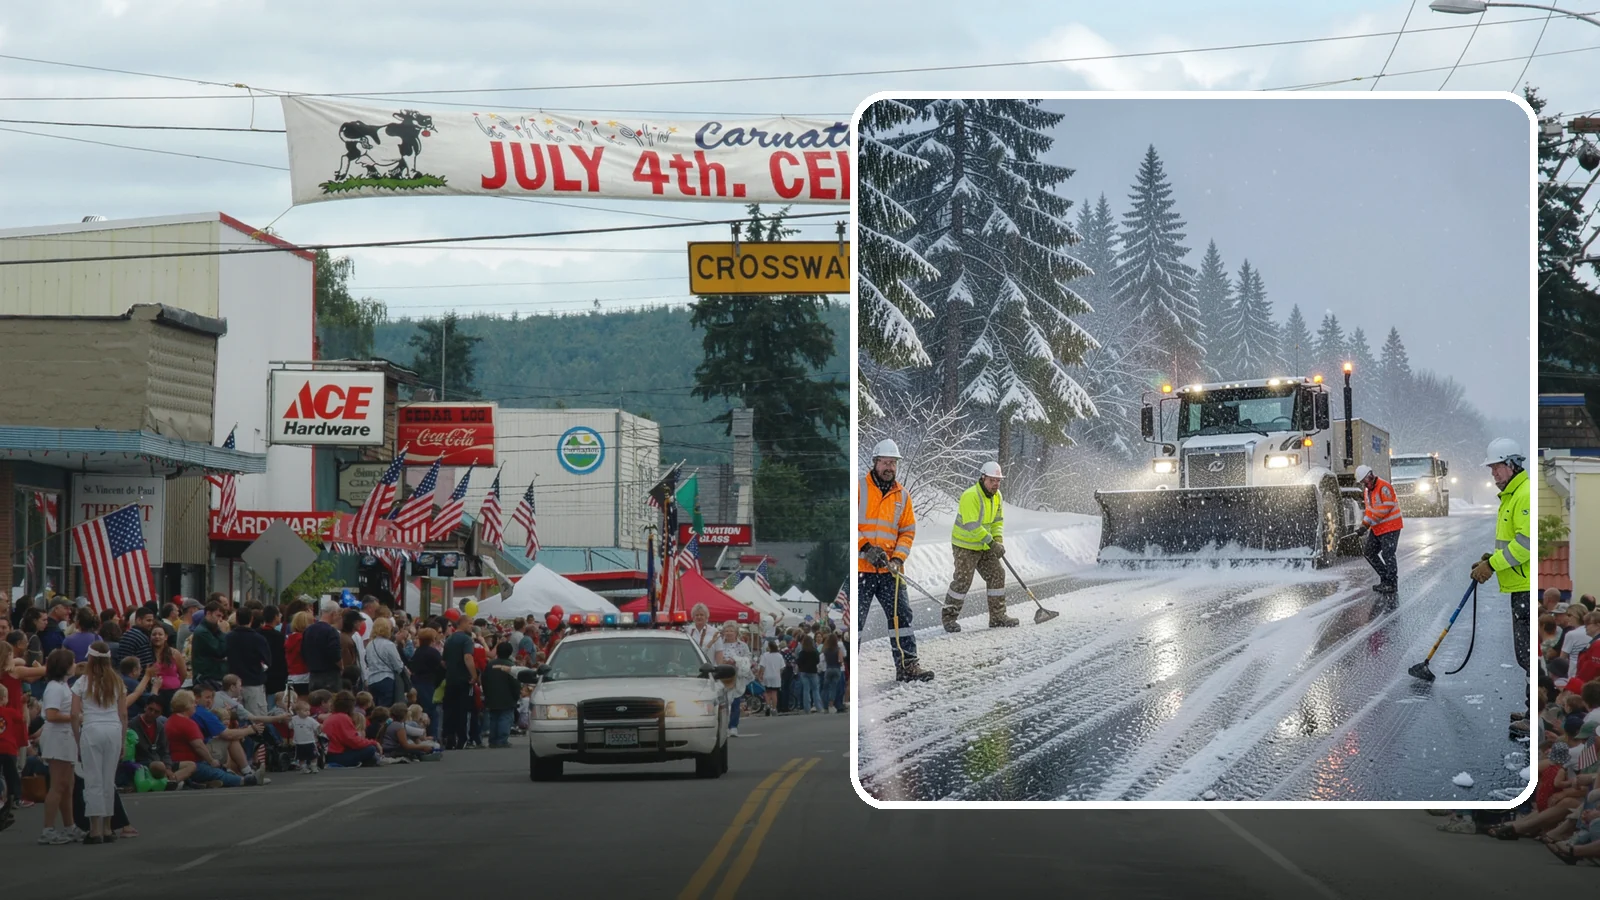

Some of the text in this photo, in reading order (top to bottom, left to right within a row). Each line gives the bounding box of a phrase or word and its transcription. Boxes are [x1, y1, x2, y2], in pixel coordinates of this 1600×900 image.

[481, 141, 605, 192] JULY
[632, 150, 746, 198] 4th.
[697, 254, 850, 280] CROSSWA
[282, 380, 374, 420] ACE
[406, 409, 452, 422] CEDAR
[283, 421, 370, 436] Hardware
[416, 428, 476, 447] Coca-Cola
[354, 467, 385, 480] Simpl
[95, 484, 124, 494] Vincent
[126, 486, 136, 494] de
[137, 485, 155, 495] Paul
[80, 503, 154, 522] THRT
[688, 526, 742, 535] CRNATION
[699, 535, 730, 543] GLASS
